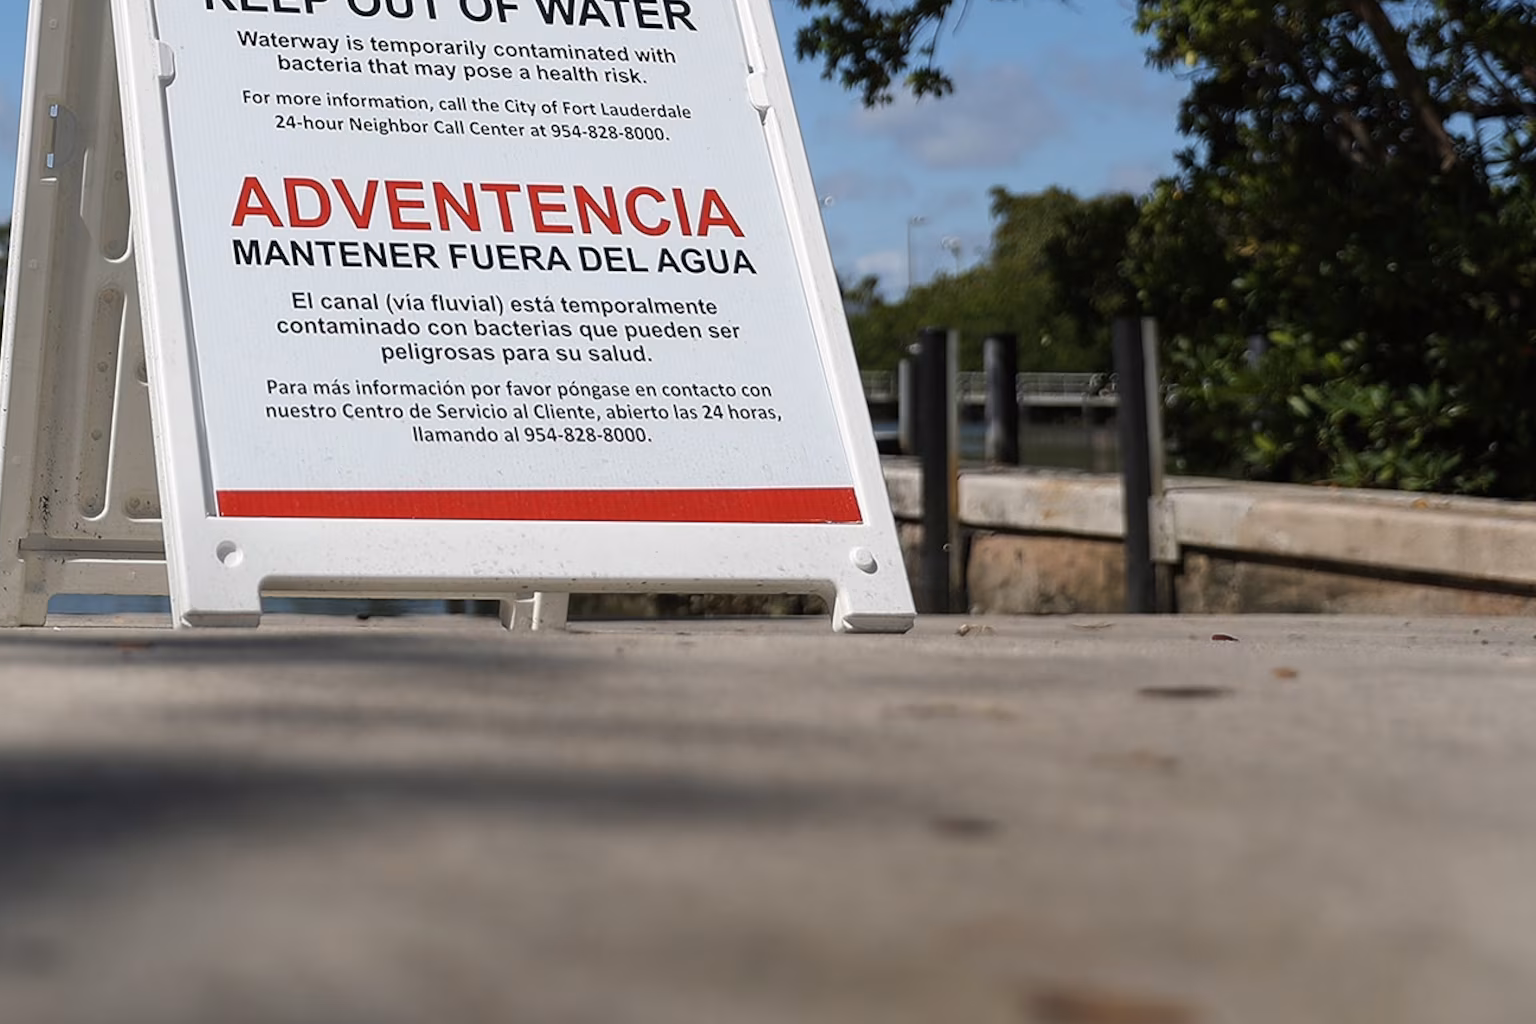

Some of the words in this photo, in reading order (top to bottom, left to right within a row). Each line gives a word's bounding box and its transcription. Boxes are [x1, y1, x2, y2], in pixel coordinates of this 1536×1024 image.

[236, 30, 340, 54] Waterway
[346, 34, 365, 51] is
[369, 36, 487, 60] temporarily
[493, 43, 630, 62] contaminated
[634, 47, 676, 64] with
[277, 54, 362, 73] bacteria
[367, 58, 409, 75] that
[414, 63, 456, 81] may
[463, 65, 513, 81] pose
[519, 67, 531, 80] a
[536, 64, 599, 82] health
[604, 67, 647, 84] risk.
[242, 89, 271, 104] For
[276, 94, 322, 106] more
[326, 92, 434, 112] information,
[438, 96, 467, 111] call
[471, 97, 500, 113] the
[504, 99, 536, 117] City
[541, 100, 558, 114] of
[562, 101, 597, 116] Fort
[600, 102, 692, 119] Lauderdale
[275, 114, 344, 131] 24-hour
[349, 117, 429, 136] Neighbor
[433, 120, 465, 135] Call
[469, 121, 525, 137] Center
[530, 125, 547, 138] at
[550, 124, 670, 141] 954-828-8000.
[231, 176, 746, 238] ADVENTENCIA
[232, 239, 440, 269] MANTENER
[448, 243, 572, 272] FUERA
[577, 246, 649, 273] DEL
[657, 247, 758, 275] AGUA
[291, 292, 313, 309] El
[320, 293, 379, 310] canal
[386, 293, 425, 315] (vía
[430, 293, 504, 317] fluvial)
[510, 296, 555, 313] está
[560, 297, 718, 318] temporalmente
[277, 317, 421, 336] contaminado
[427, 322, 468, 336] con
[473, 319, 573, 337] bacterias
[579, 324, 618, 342] que
[624, 321, 702, 342] pueden
[708, 325, 740, 339] ser
[381, 342, 496, 365] peligrosas
[502, 347, 550, 365] para
[555, 348, 582, 362] su
[588, 344, 652, 362] salud.
[266, 379, 308, 395] Para
[313, 378, 351, 395] más
[355, 379, 466, 396] información
[470, 384, 501, 400] por
[505, 380, 552, 397] favor
[557, 380, 630, 400] póngase
[635, 385, 657, 397] en
[661, 383, 737, 398] contacto
[741, 385, 772, 398] con
[266, 404, 337, 419] nuestro
[342, 403, 404, 419] Centro
[409, 402, 432, 419] de
[436, 403, 508, 419] Servicio
[513, 403, 529, 419] al
[533, 403, 601, 422] Cliente,
[606, 403, 669, 420] abierto
[673, 404, 698, 420] las
[701, 404, 724, 420] 24
[727, 404, 782, 422] horas,
[412, 426, 499, 443] llamando
[504, 426, 520, 443] al
[523, 427, 652, 443] 954-828-8000.
